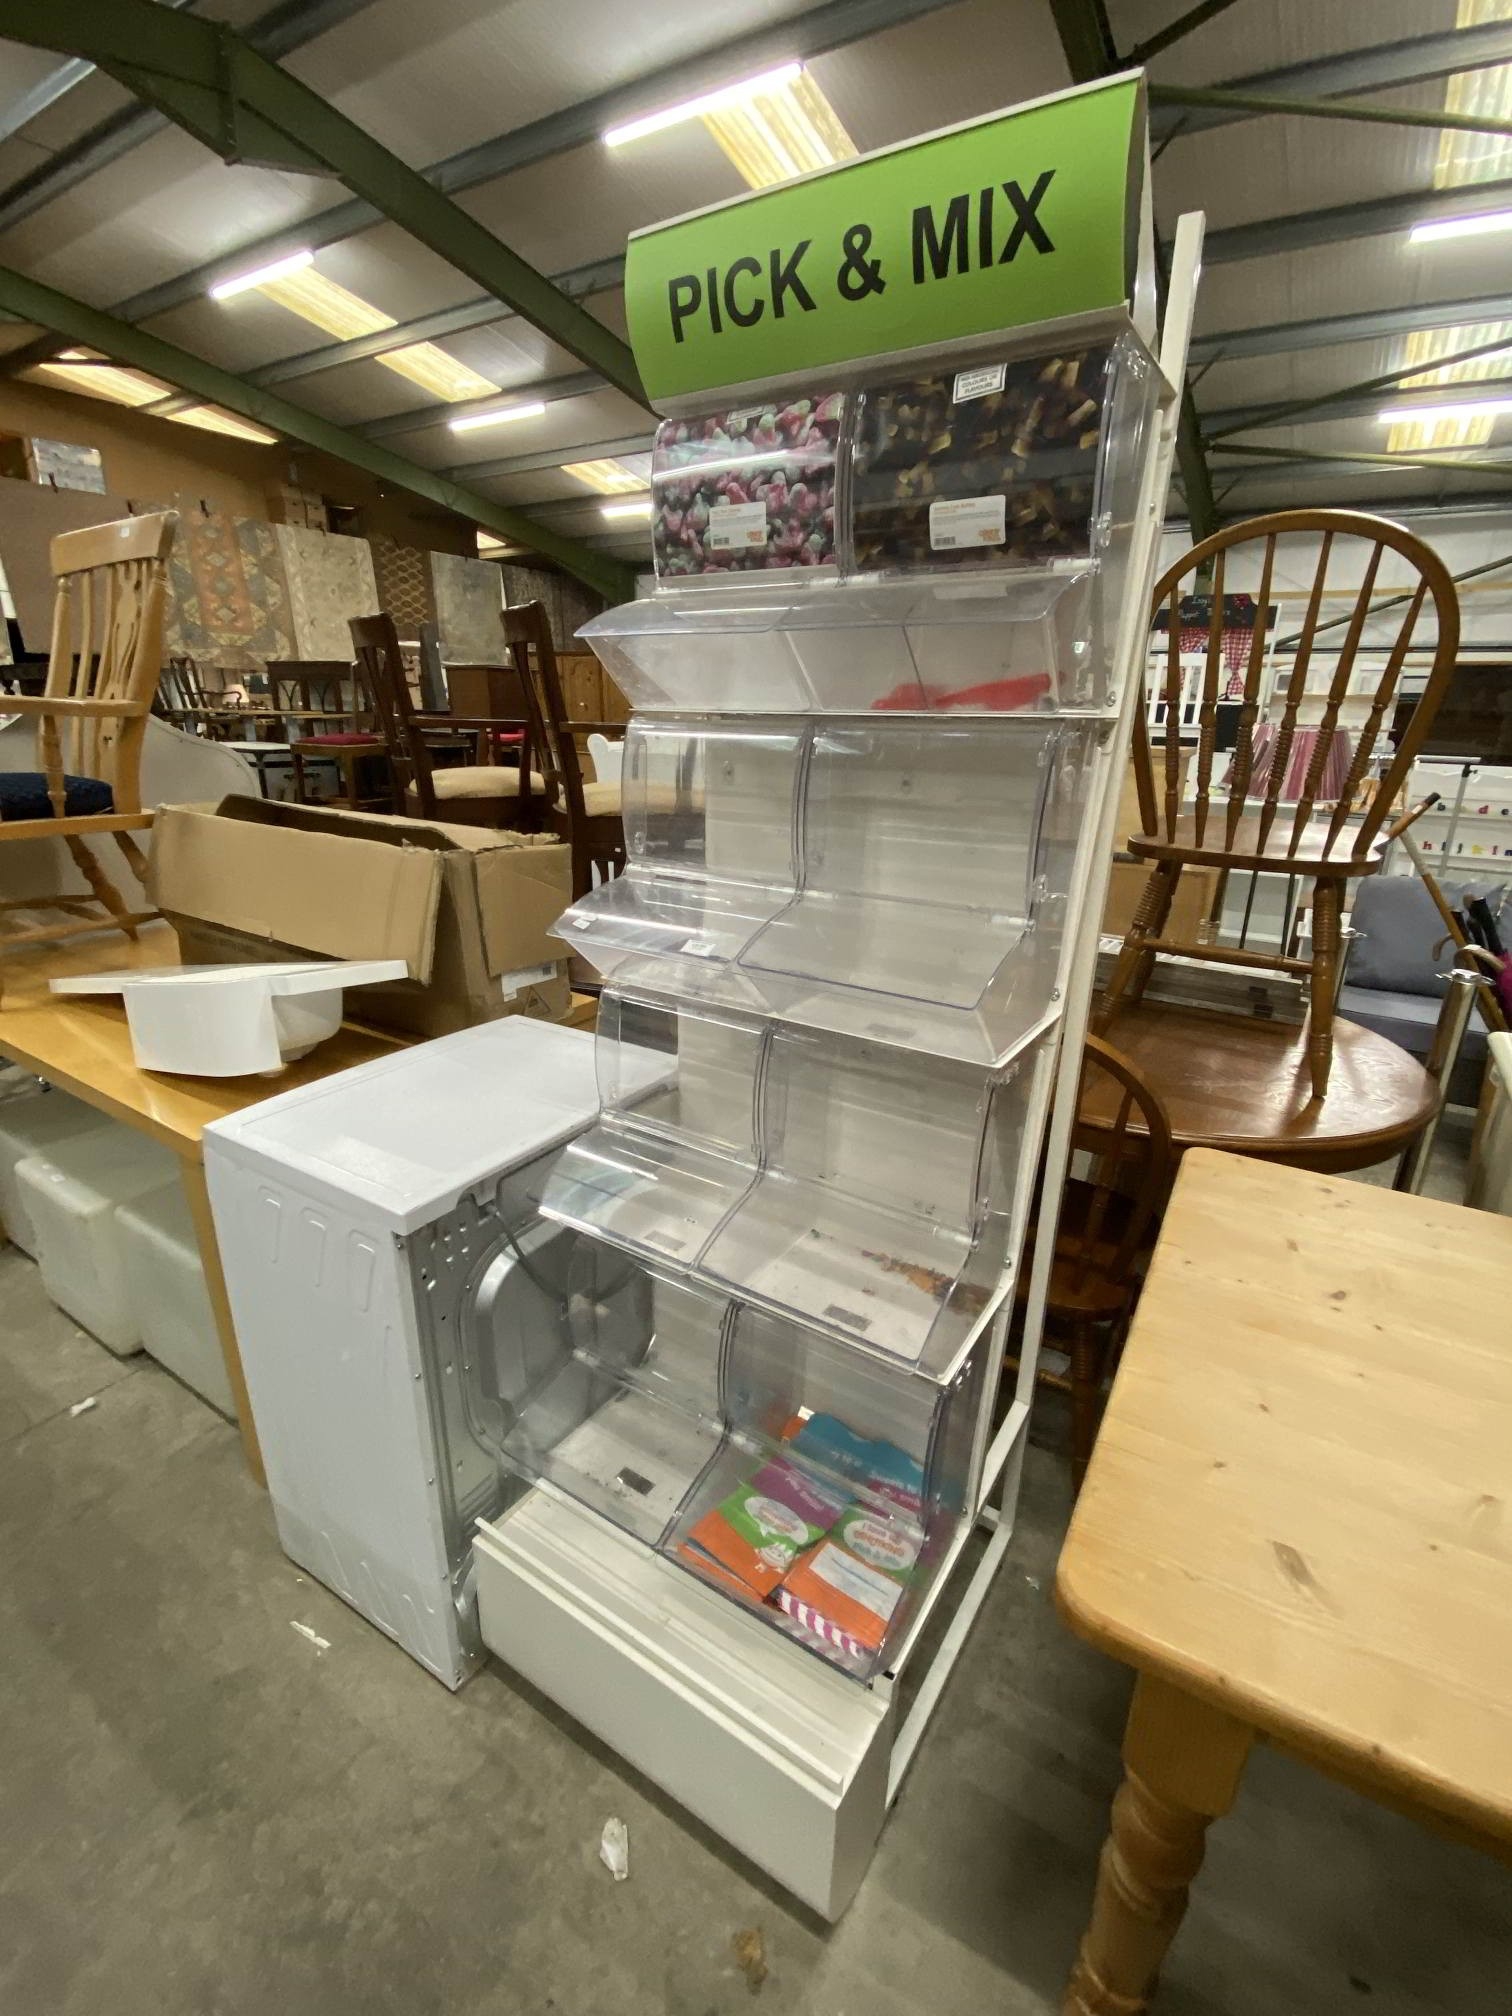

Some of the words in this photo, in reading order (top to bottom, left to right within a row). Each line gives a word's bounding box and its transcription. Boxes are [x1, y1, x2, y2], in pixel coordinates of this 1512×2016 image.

[669, 239, 818, 345] PICK
[836, 222, 887, 302] &
[911, 168, 1057, 286] MIX
